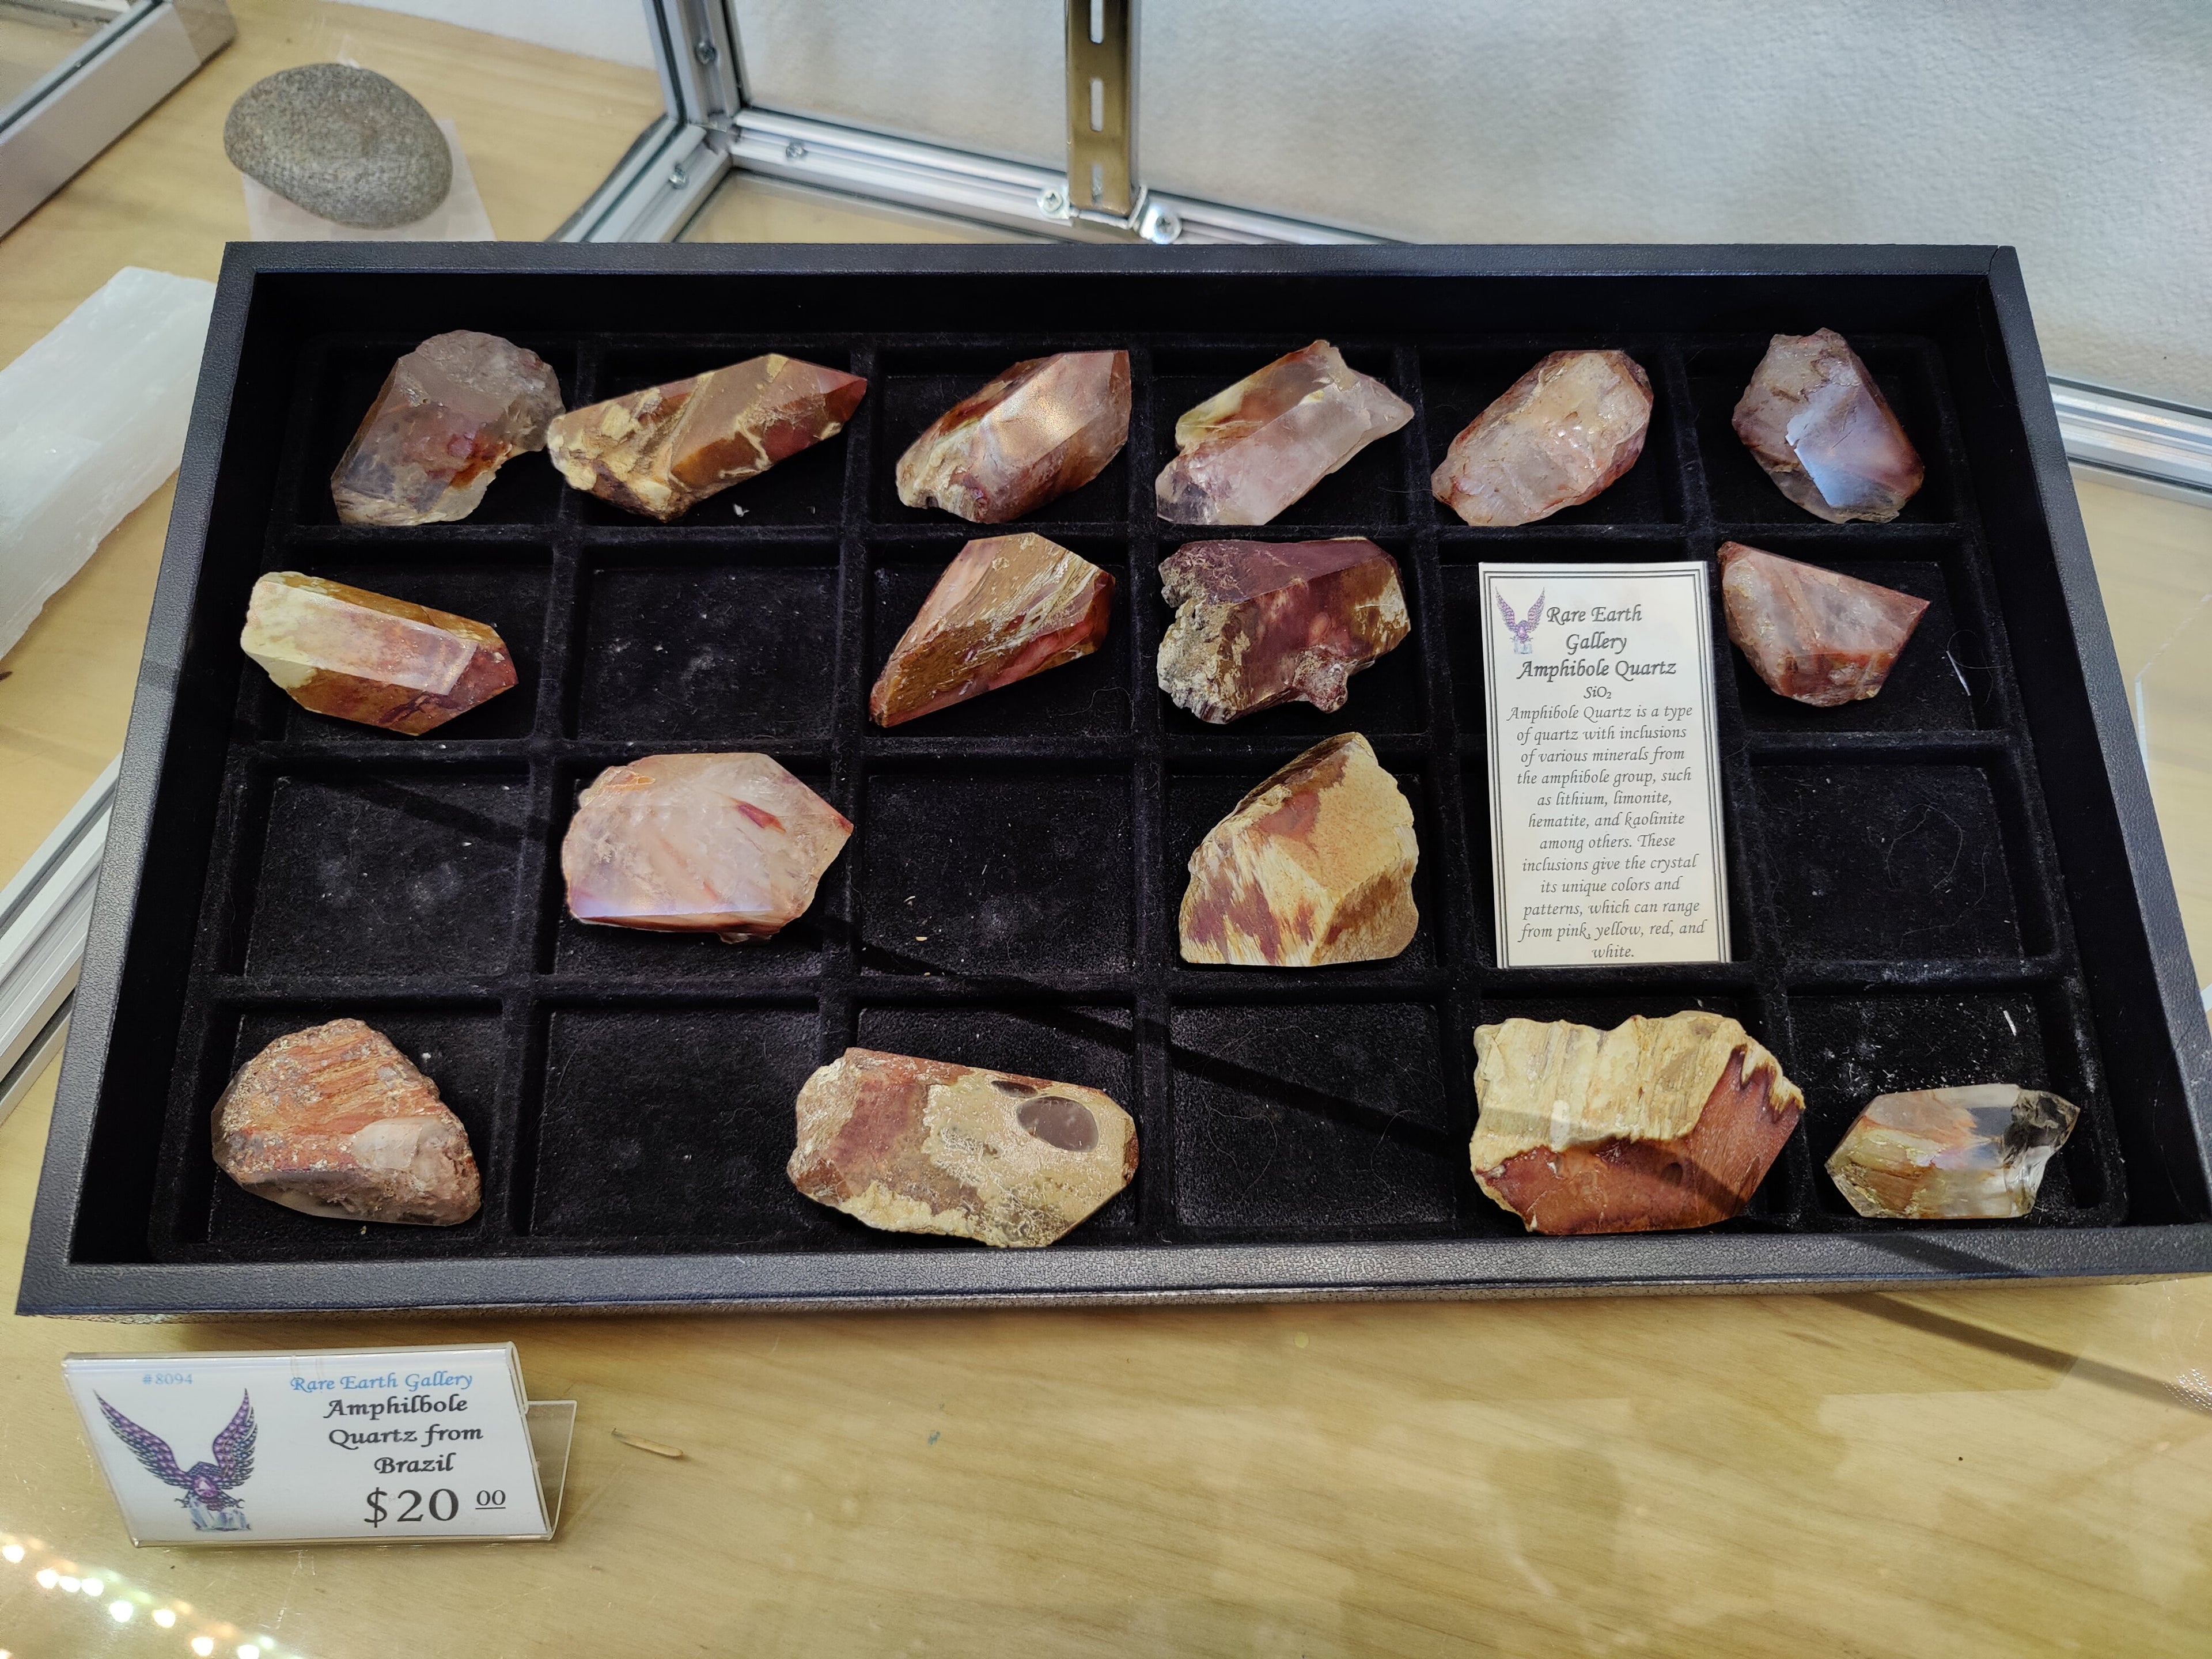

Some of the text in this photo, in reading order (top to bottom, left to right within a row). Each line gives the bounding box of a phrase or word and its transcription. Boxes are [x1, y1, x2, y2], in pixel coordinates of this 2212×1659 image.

[1546, 604, 1642, 626] Rare Earth
[1566, 631, 1627, 656] Gallery
[1516, 658, 1677, 683] Amphibole Quartz
[1506, 704, 1693, 724] Amphibole Quartz is a type
[1517, 724, 1687, 746] of quartz with inclusions
[1521, 745, 1685, 767] of various minerals from
[1517, 766, 1692, 789] the amphibole group, such
[1537, 790, 1672, 808] as lithium, limonite,
[1528, 810, 1685, 830] hematite, and kaolinite
[1539, 832, 1676, 854] among others. These
[1522, 853, 1700, 876] inclusions give the crystal
[1540, 875, 1684, 897] its unique colors and
[1522, 899, 1700, 921] patterns, which can range
[1517, 919, 1709, 943] from pink, yellow, red, and
[1591, 943, 1634, 959] white.
[142, 1373, 193, 1385] #8094
[290, 1370, 473, 1393] Rare Earth Gallery
[323, 1393, 468, 1421] Amphilbole
[328, 1423, 484, 1450] Quartz from
[374, 1452, 457, 1474] Brazil
[363, 1487, 506, 1528] $20 00
